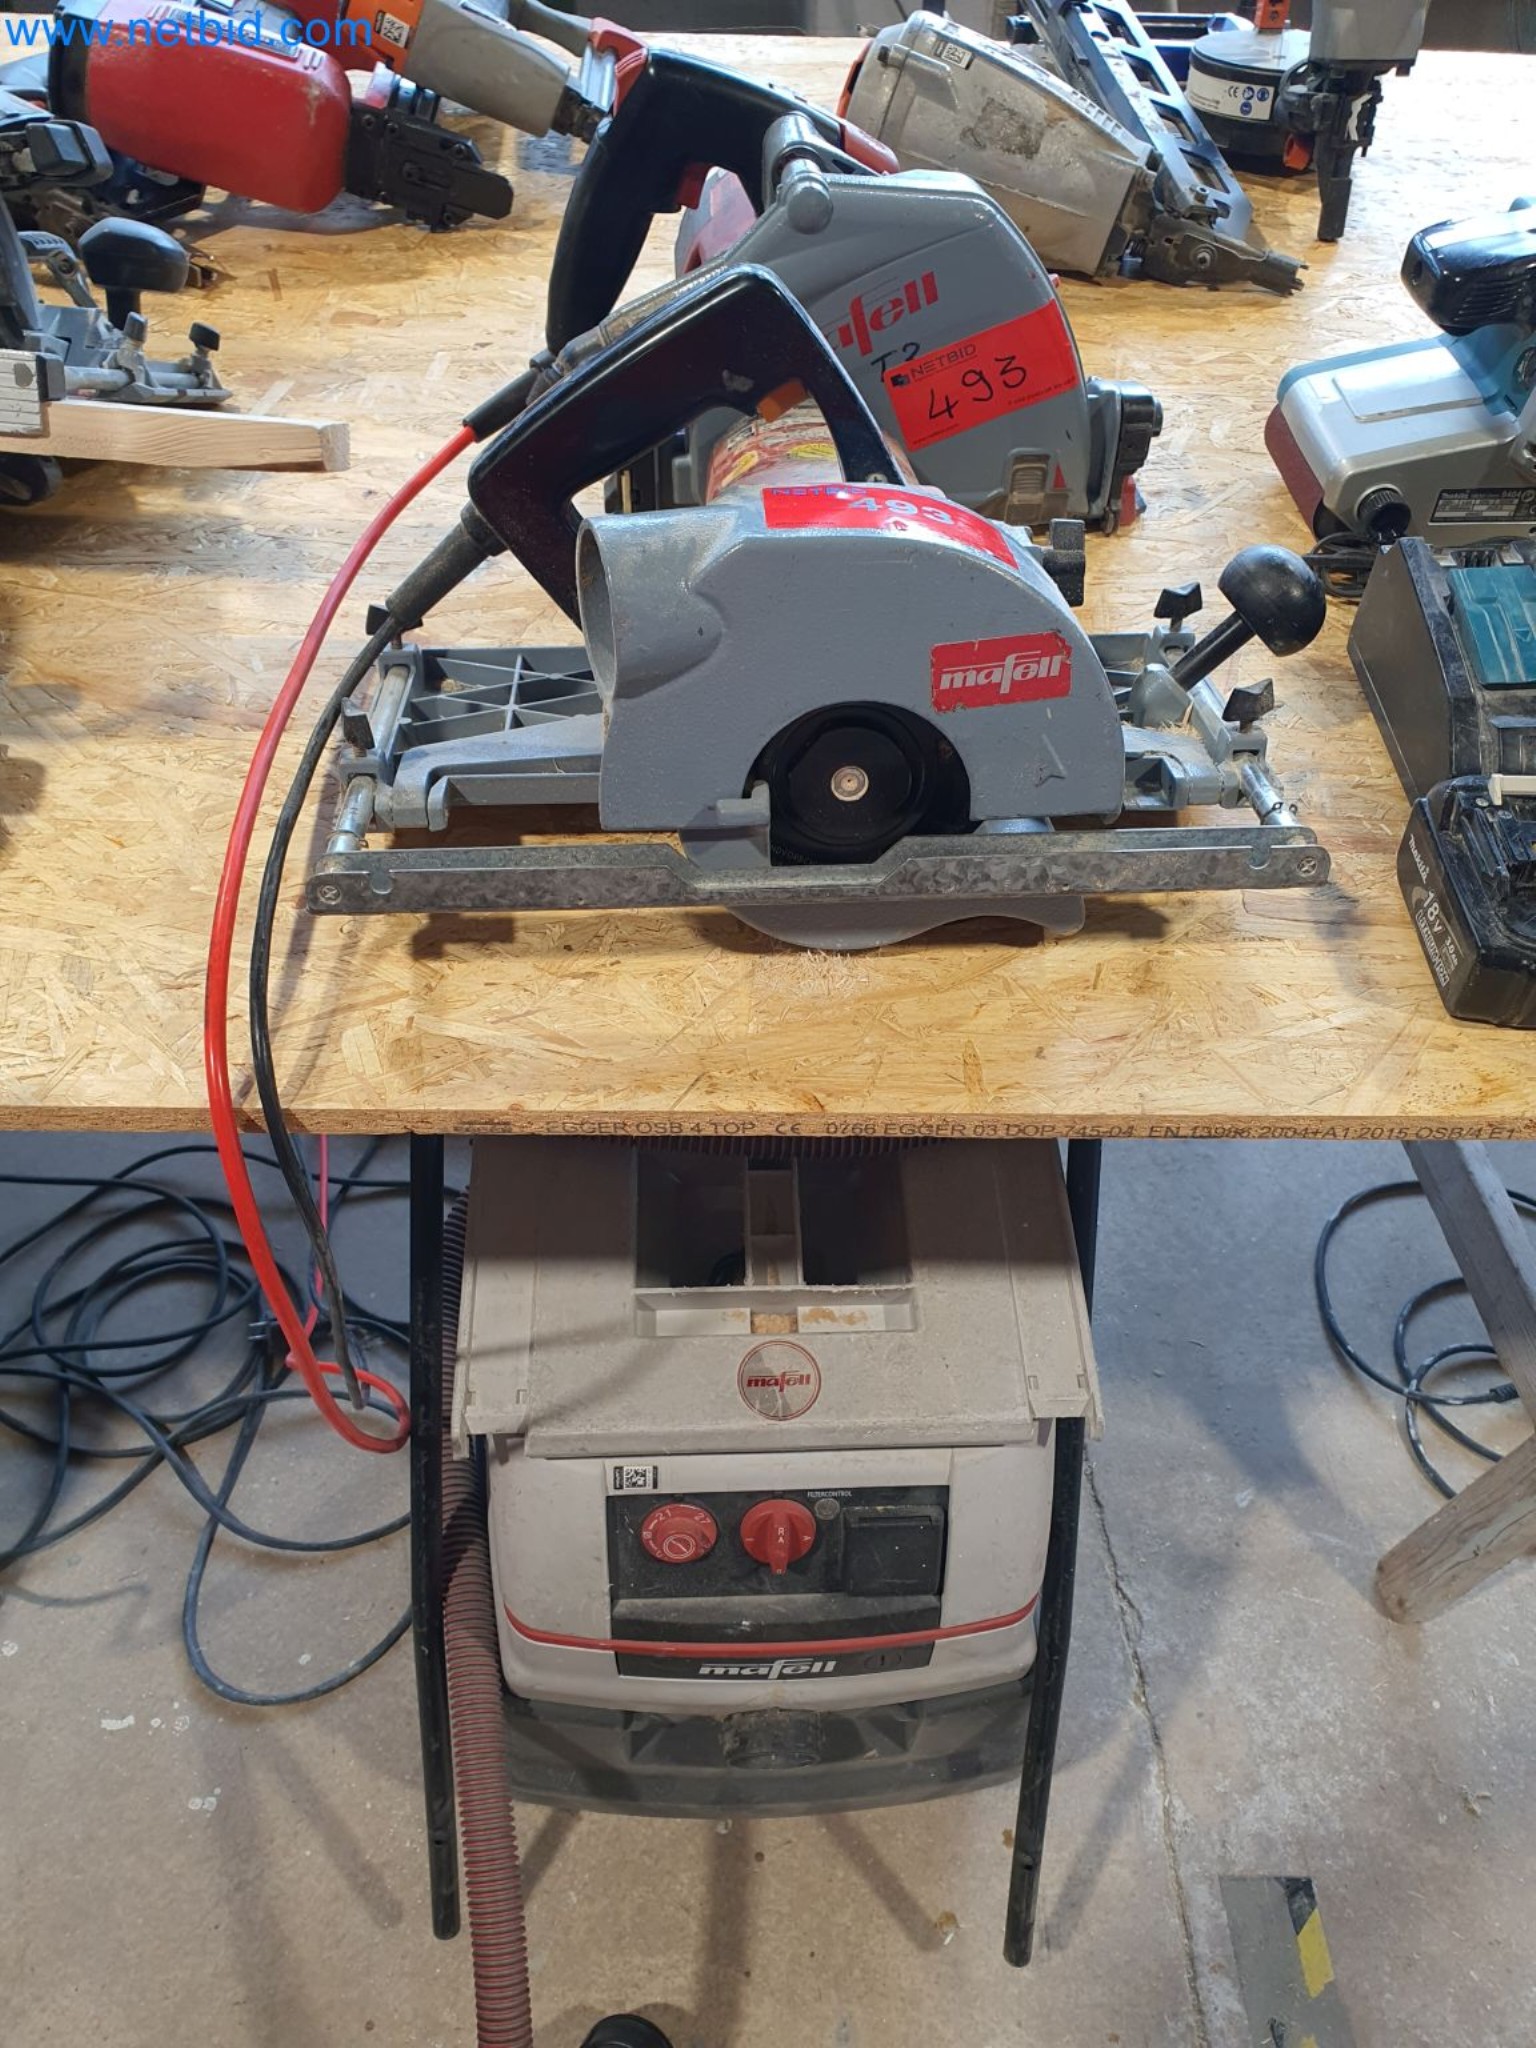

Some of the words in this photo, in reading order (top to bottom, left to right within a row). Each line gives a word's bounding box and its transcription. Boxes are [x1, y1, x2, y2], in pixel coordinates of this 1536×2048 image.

[910, 344, 977, 378] NETBID
[928, 355, 1027, 419] 493
[848, 497, 954, 525] 493
[940, 650, 1063, 694] mafell
[635, 1121, 682, 1135] OSB
[709, 1121, 756, 1135] TOP
[883, 1122, 966, 1136] EGGER
[746, 1370, 811, 1393] mafell
[699, 1658, 837, 1680] mafell
